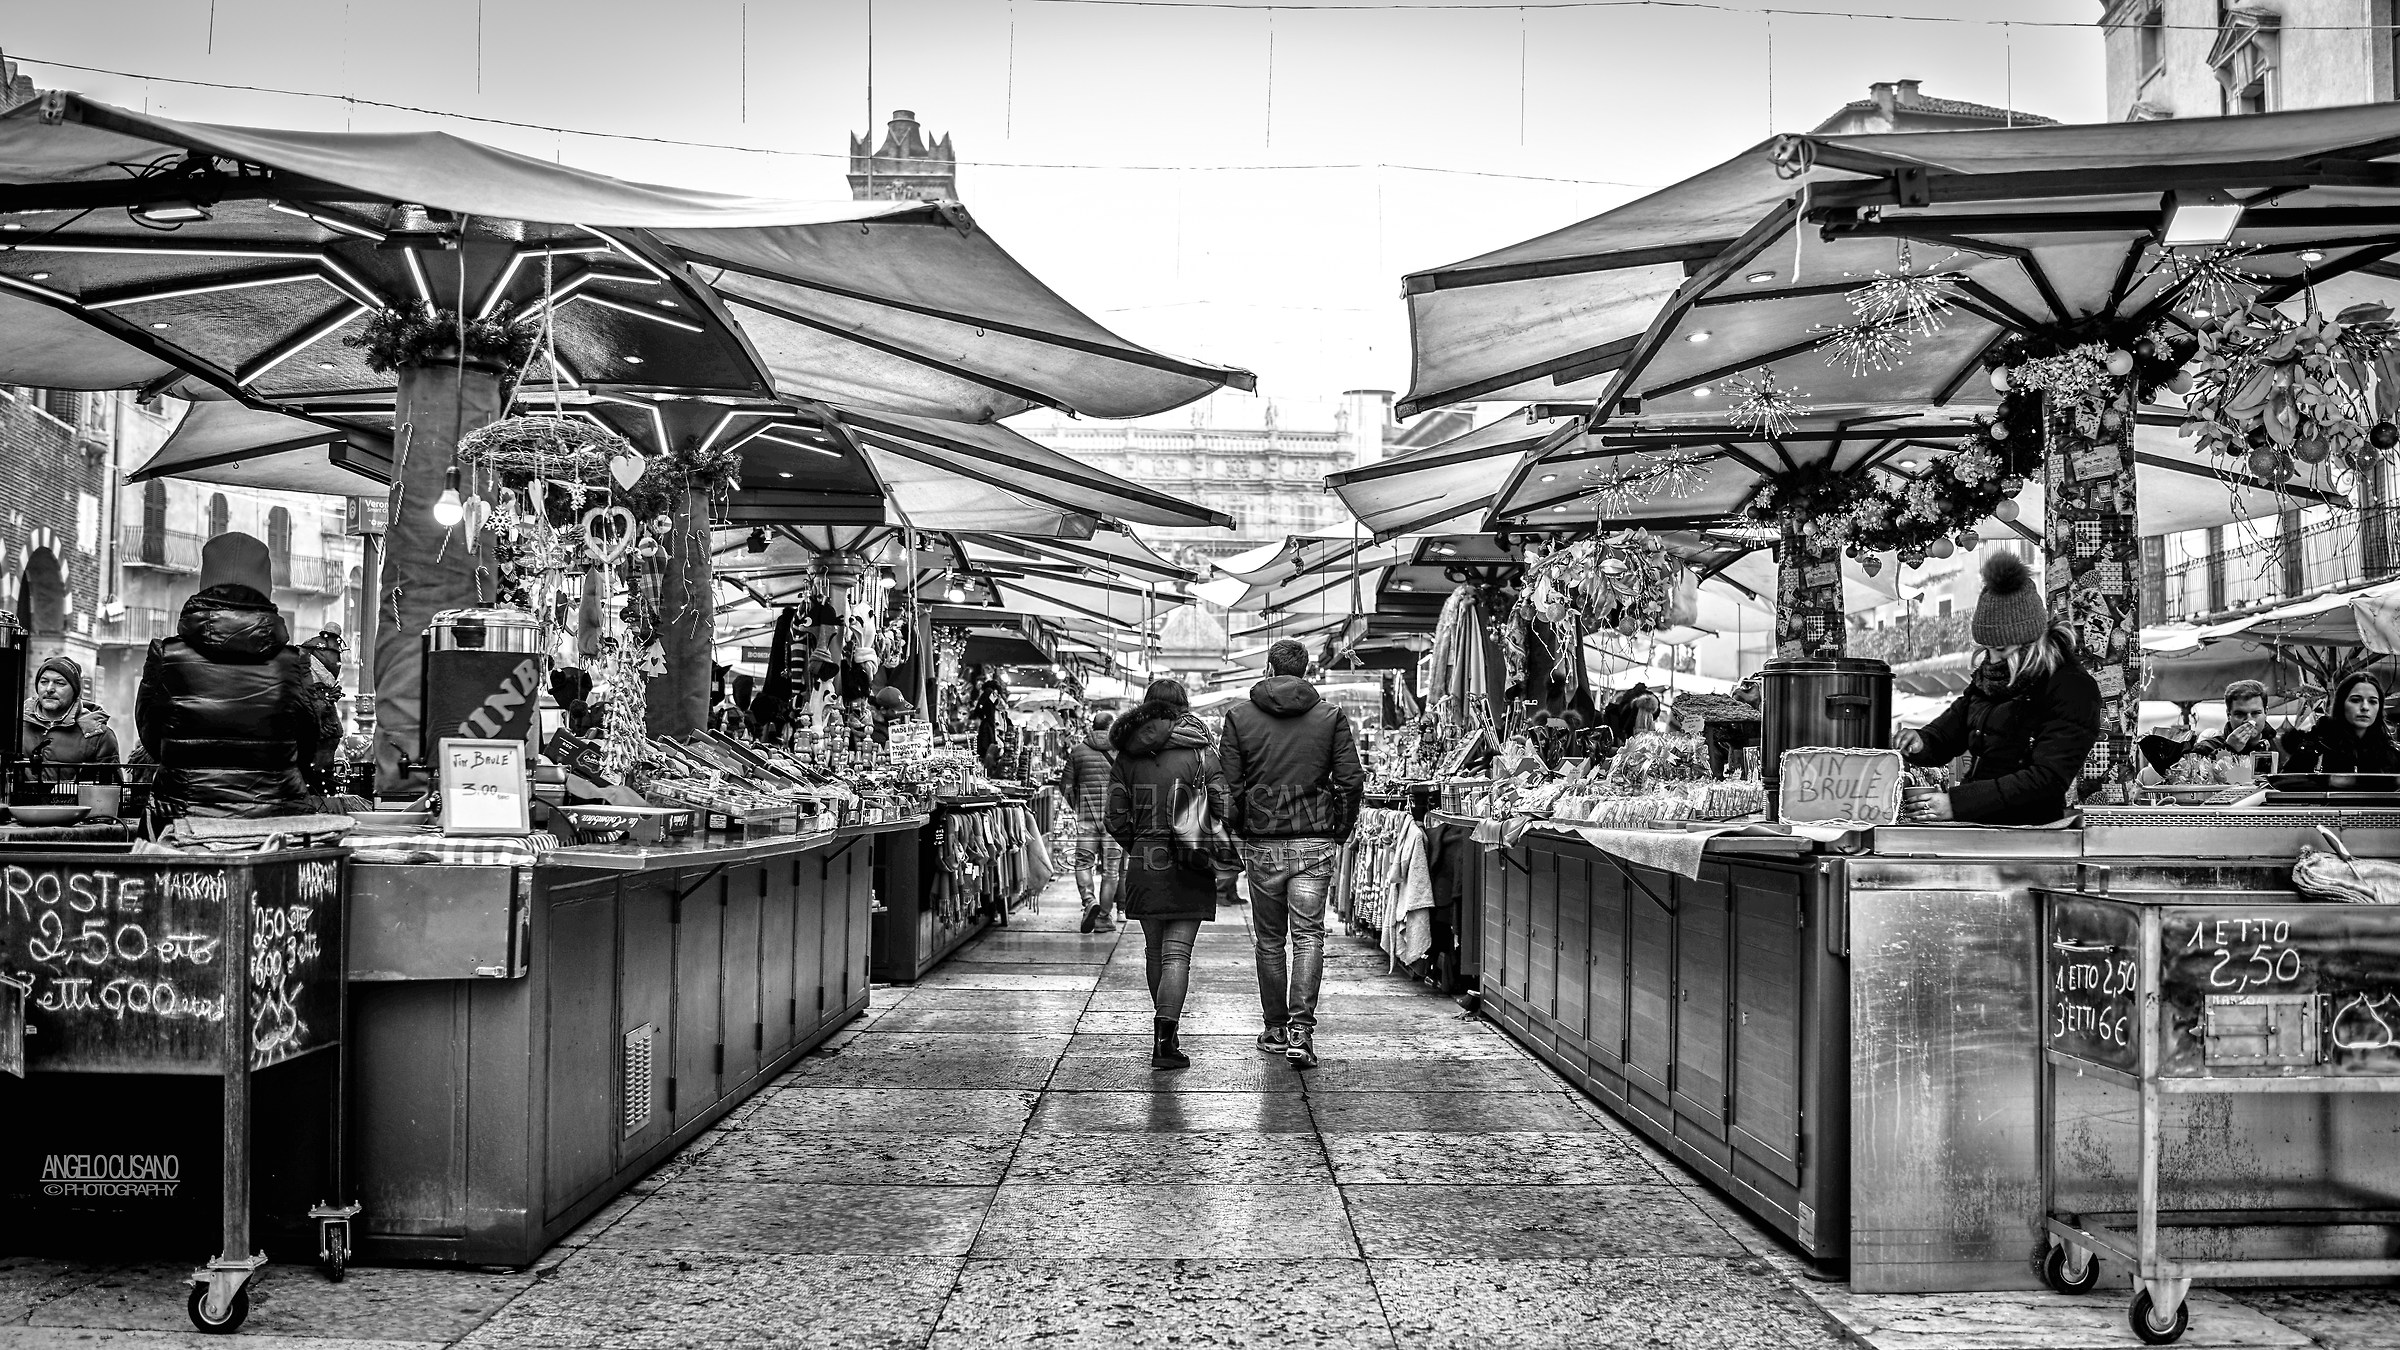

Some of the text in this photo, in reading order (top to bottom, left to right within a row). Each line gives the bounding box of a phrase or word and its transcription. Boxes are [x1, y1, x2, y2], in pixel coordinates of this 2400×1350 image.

[1796, 753, 1847, 777] VIN
[0, 865, 145, 921] ROSTE
[29, 910, 148, 965] 2,50
[2187, 918, 2290, 949] 1 ETTO
[2055, 959, 2137, 998] 1 ETTO 2,50
[2210, 944, 2301, 993] 2,50
[2053, 1002, 2065, 1038] 3
[2068, 1005, 2096, 1032] ETTI
